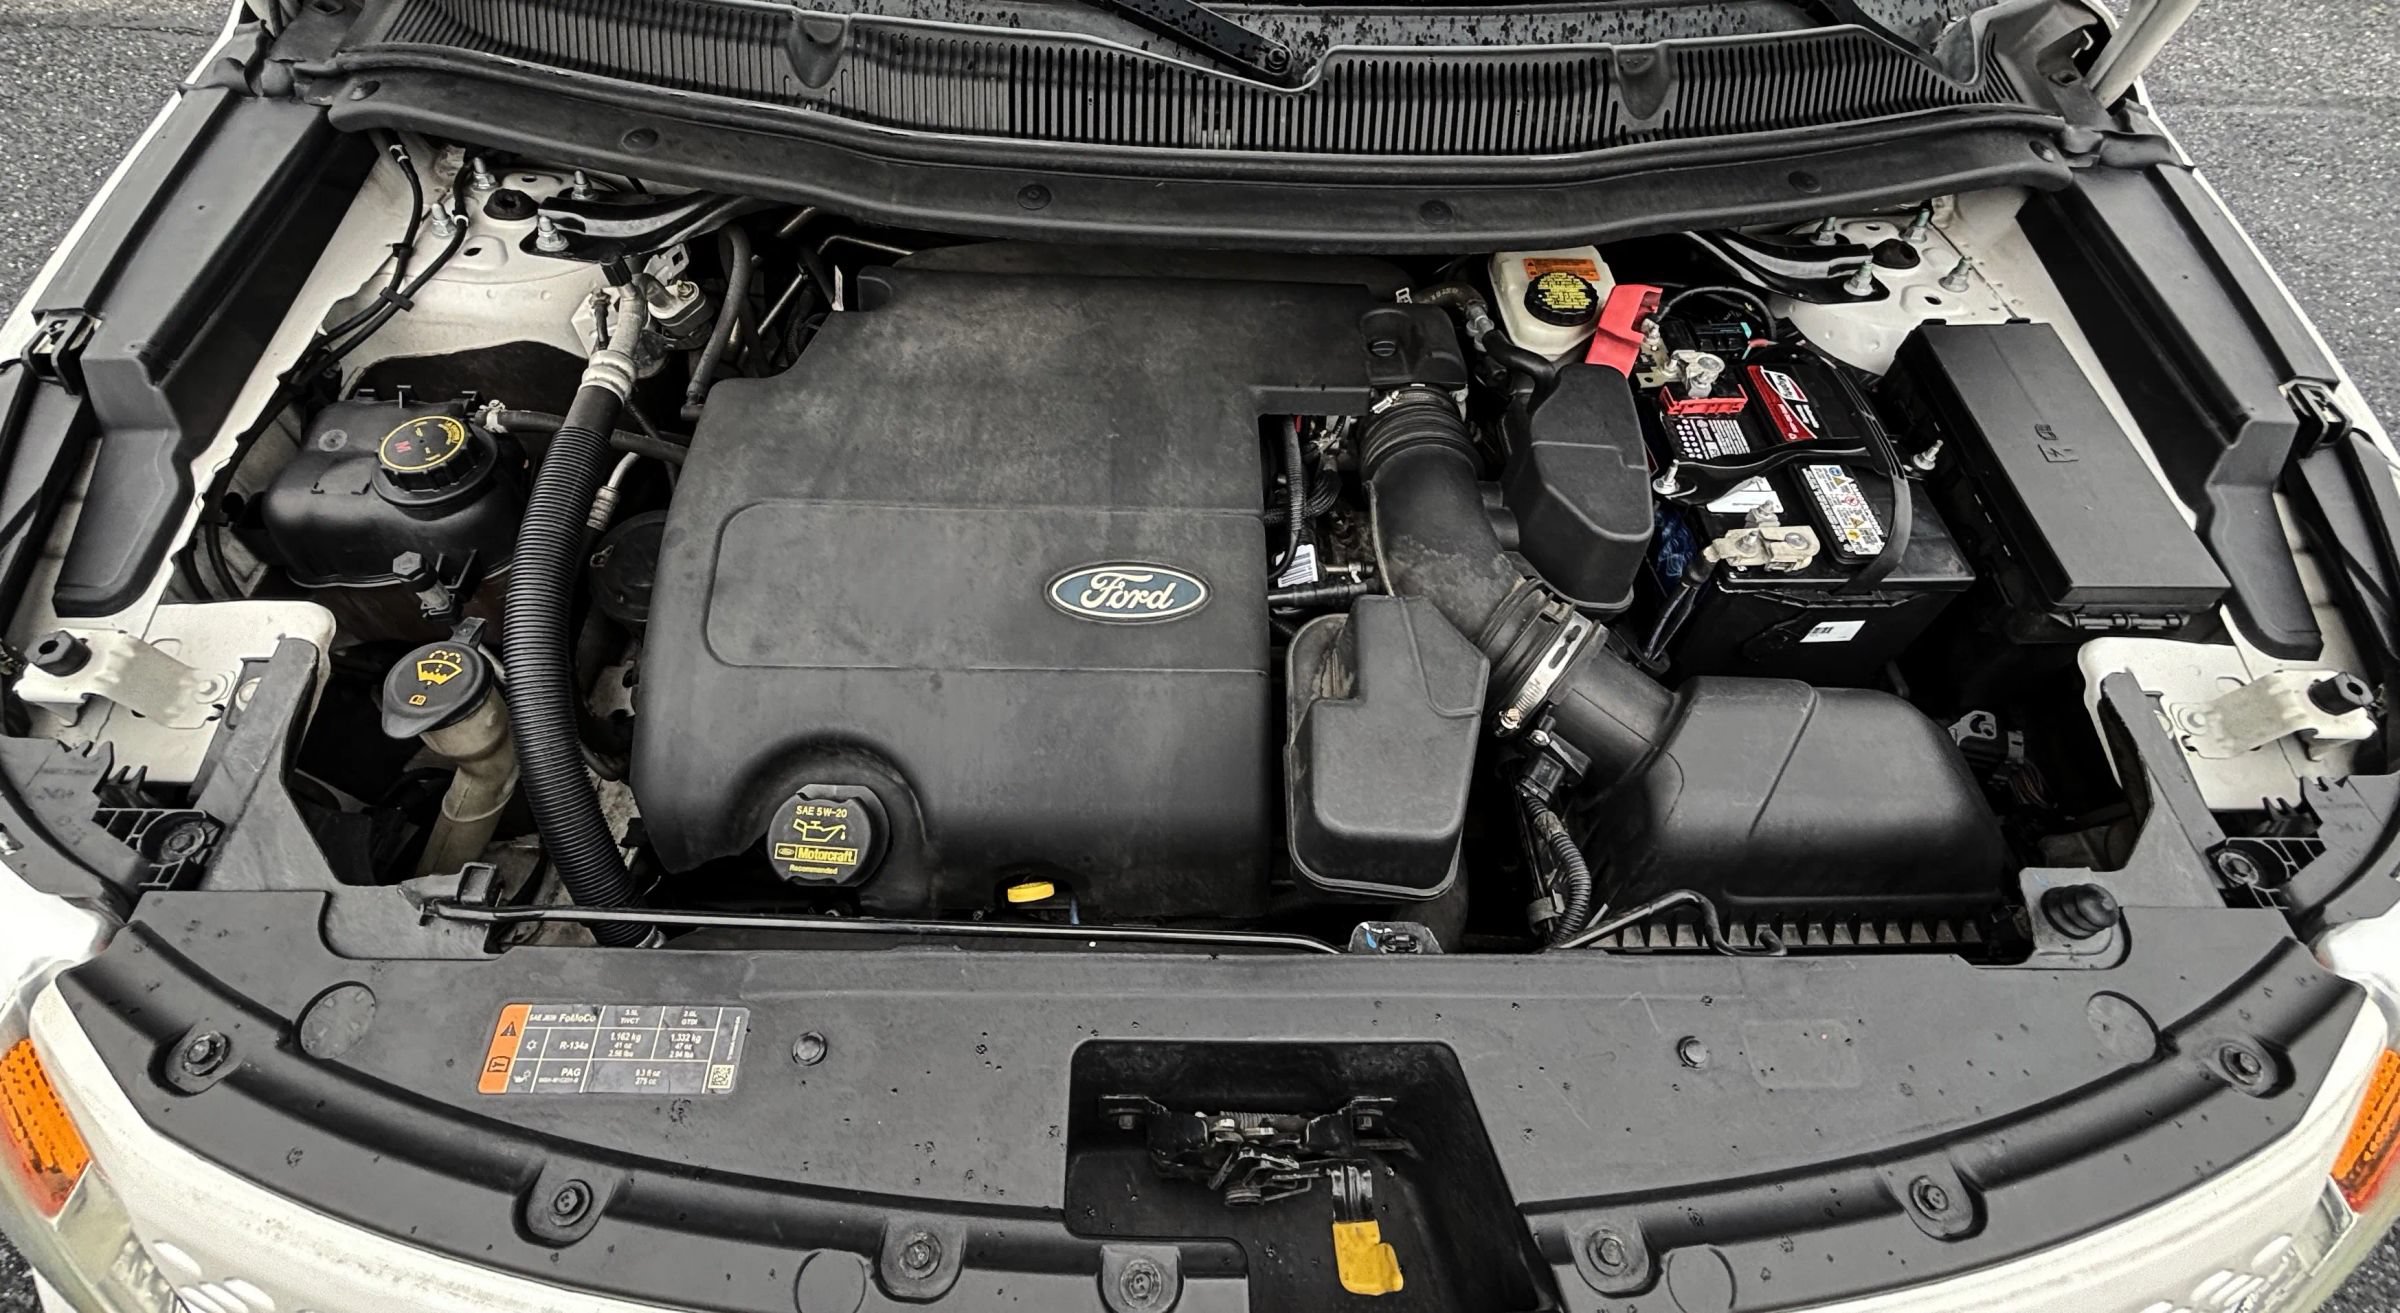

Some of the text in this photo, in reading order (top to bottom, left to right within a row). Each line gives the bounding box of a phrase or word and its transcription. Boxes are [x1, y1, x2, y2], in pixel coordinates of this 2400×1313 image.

[1080, 571, 1177, 610] Ford
[796, 805, 847, 818] SAE 5W-20
[798, 847, 853, 863] Motorcraft
[789, 865, 838, 874] Recommended
[631, 1032, 642, 1043] kg
[691, 1033, 702, 1044] kg
[559, 1041, 589, 1050] R-134a
[561, 1067, 582, 1077] PAG
